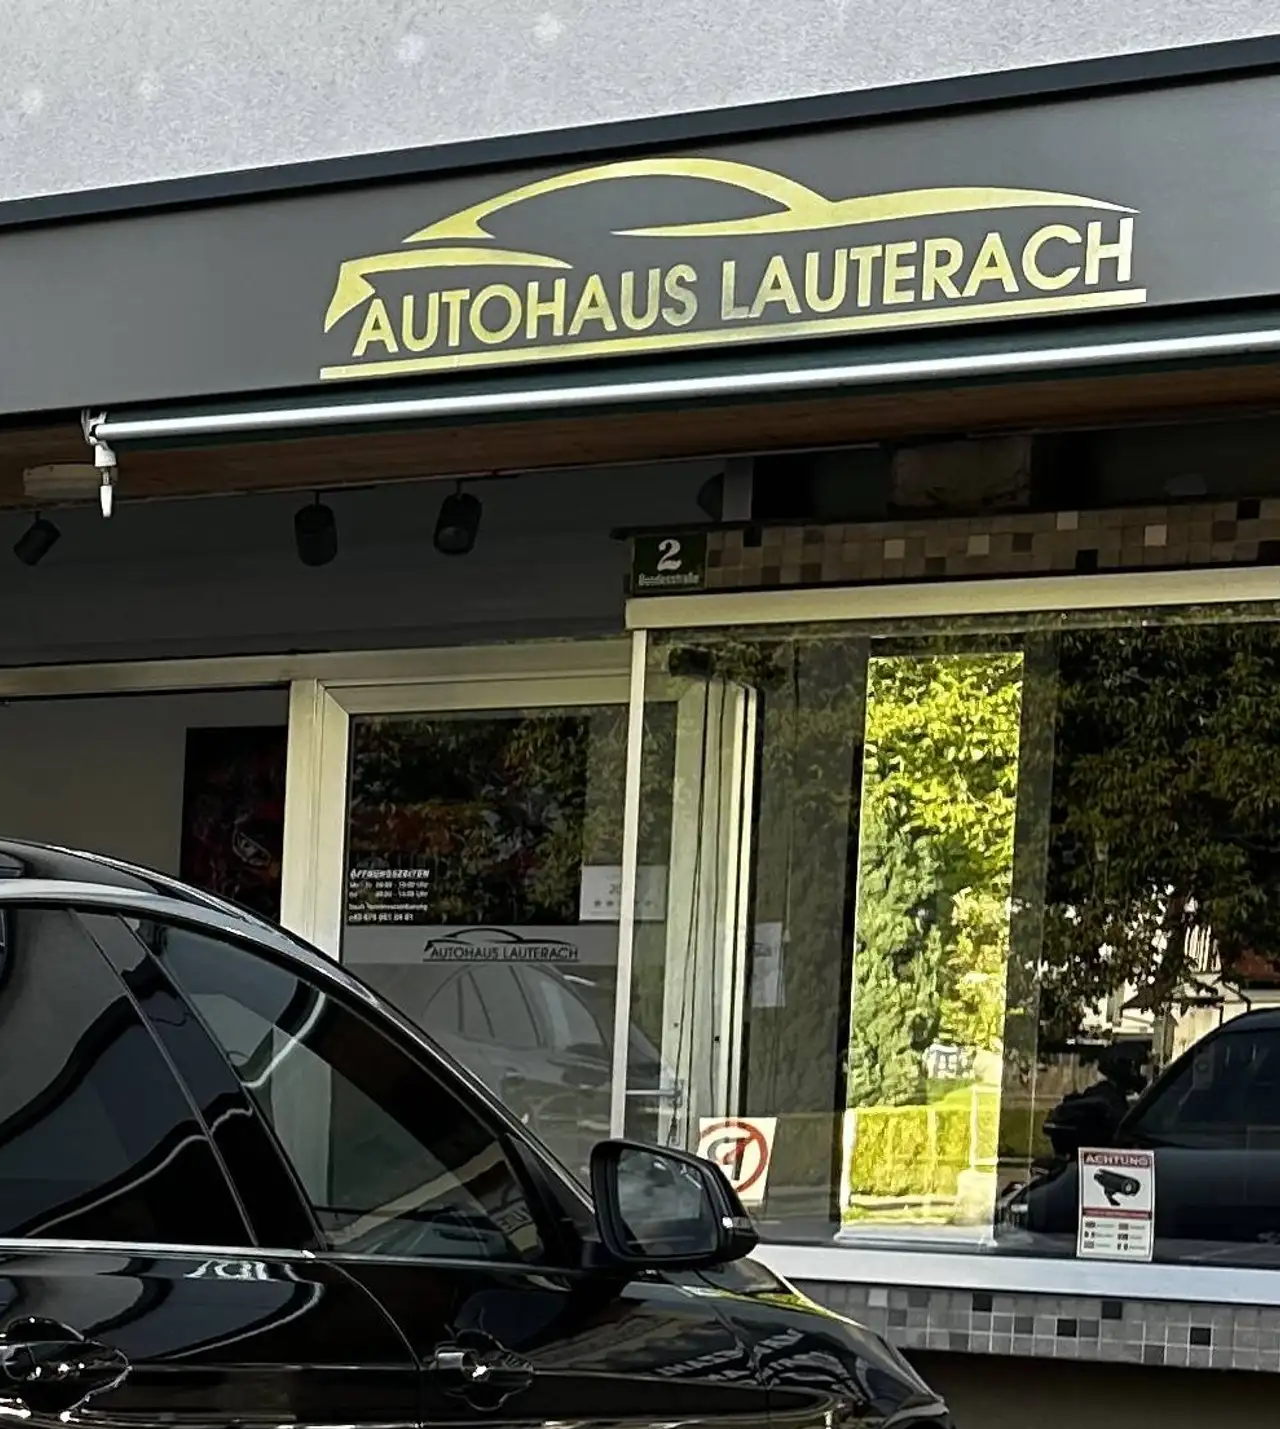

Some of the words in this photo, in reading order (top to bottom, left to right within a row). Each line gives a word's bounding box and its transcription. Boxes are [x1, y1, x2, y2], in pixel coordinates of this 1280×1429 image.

[351, 263, 698, 357] AUTOHAUS
[720, 217, 1134, 322] LAUTERACH
[656, 538, 683, 572] 2
[430, 947, 499, 959] AUTOHAUS
[502, 946, 579, 960] LAUTERACH
[1084, 1153, 1149, 1167] ACHTUNG
